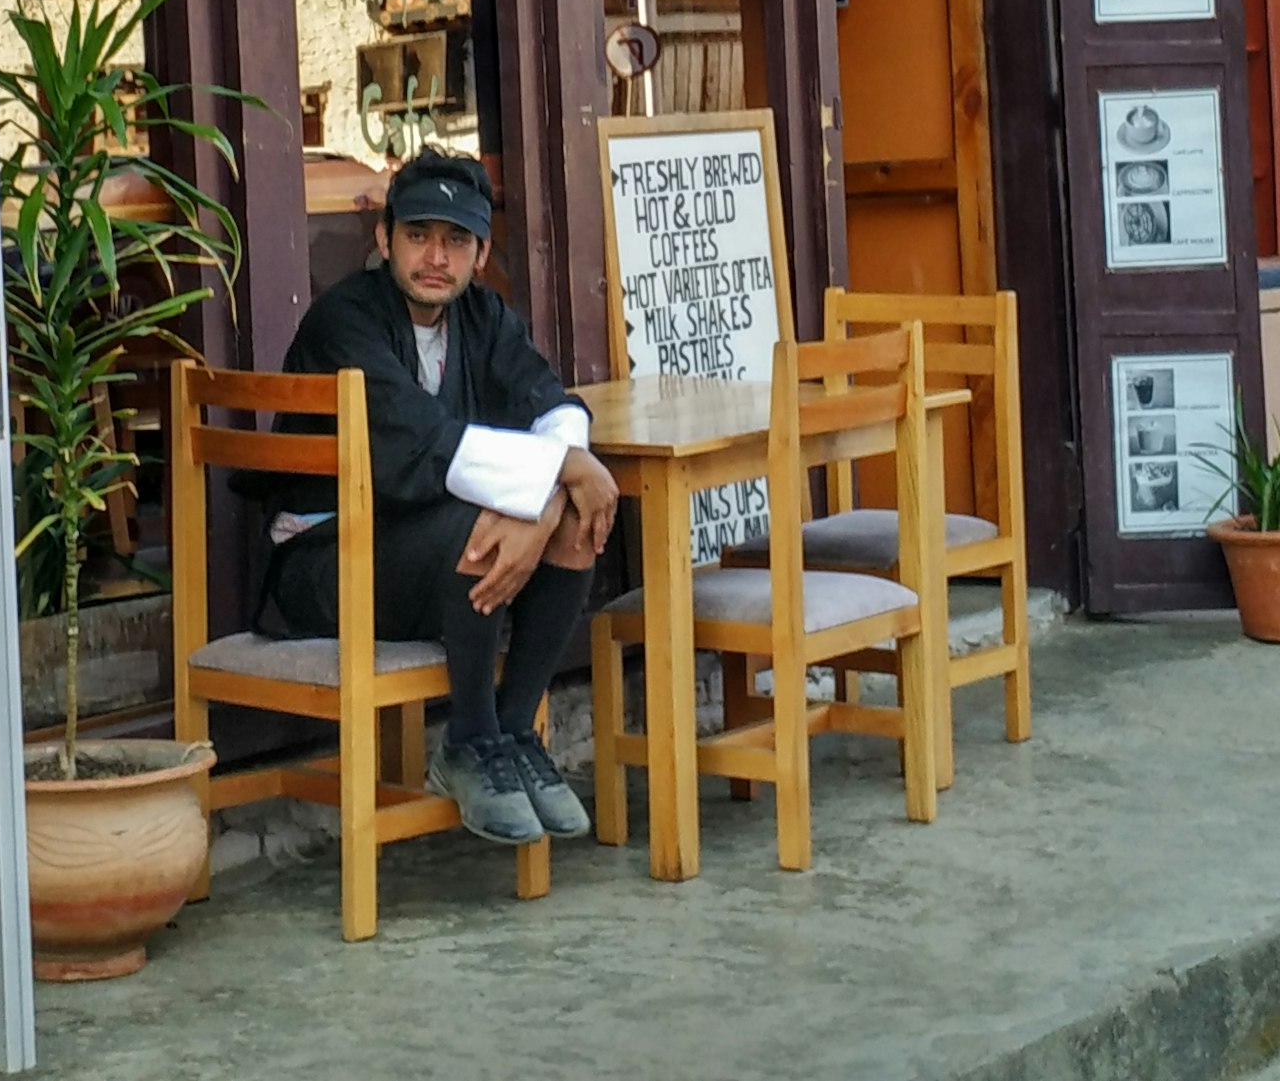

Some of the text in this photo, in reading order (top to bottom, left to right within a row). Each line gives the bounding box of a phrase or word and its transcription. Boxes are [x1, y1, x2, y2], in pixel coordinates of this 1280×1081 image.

[618, 152, 762, 197] FRESHLY BREWED
[634, 189, 736, 234] HOT & COLD
[649, 229, 718, 268] COFFEES
[626, 272, 657, 310] HOT
[662, 262, 731, 305] VARIETIES
[657, 334, 735, 376] PASTRIES
